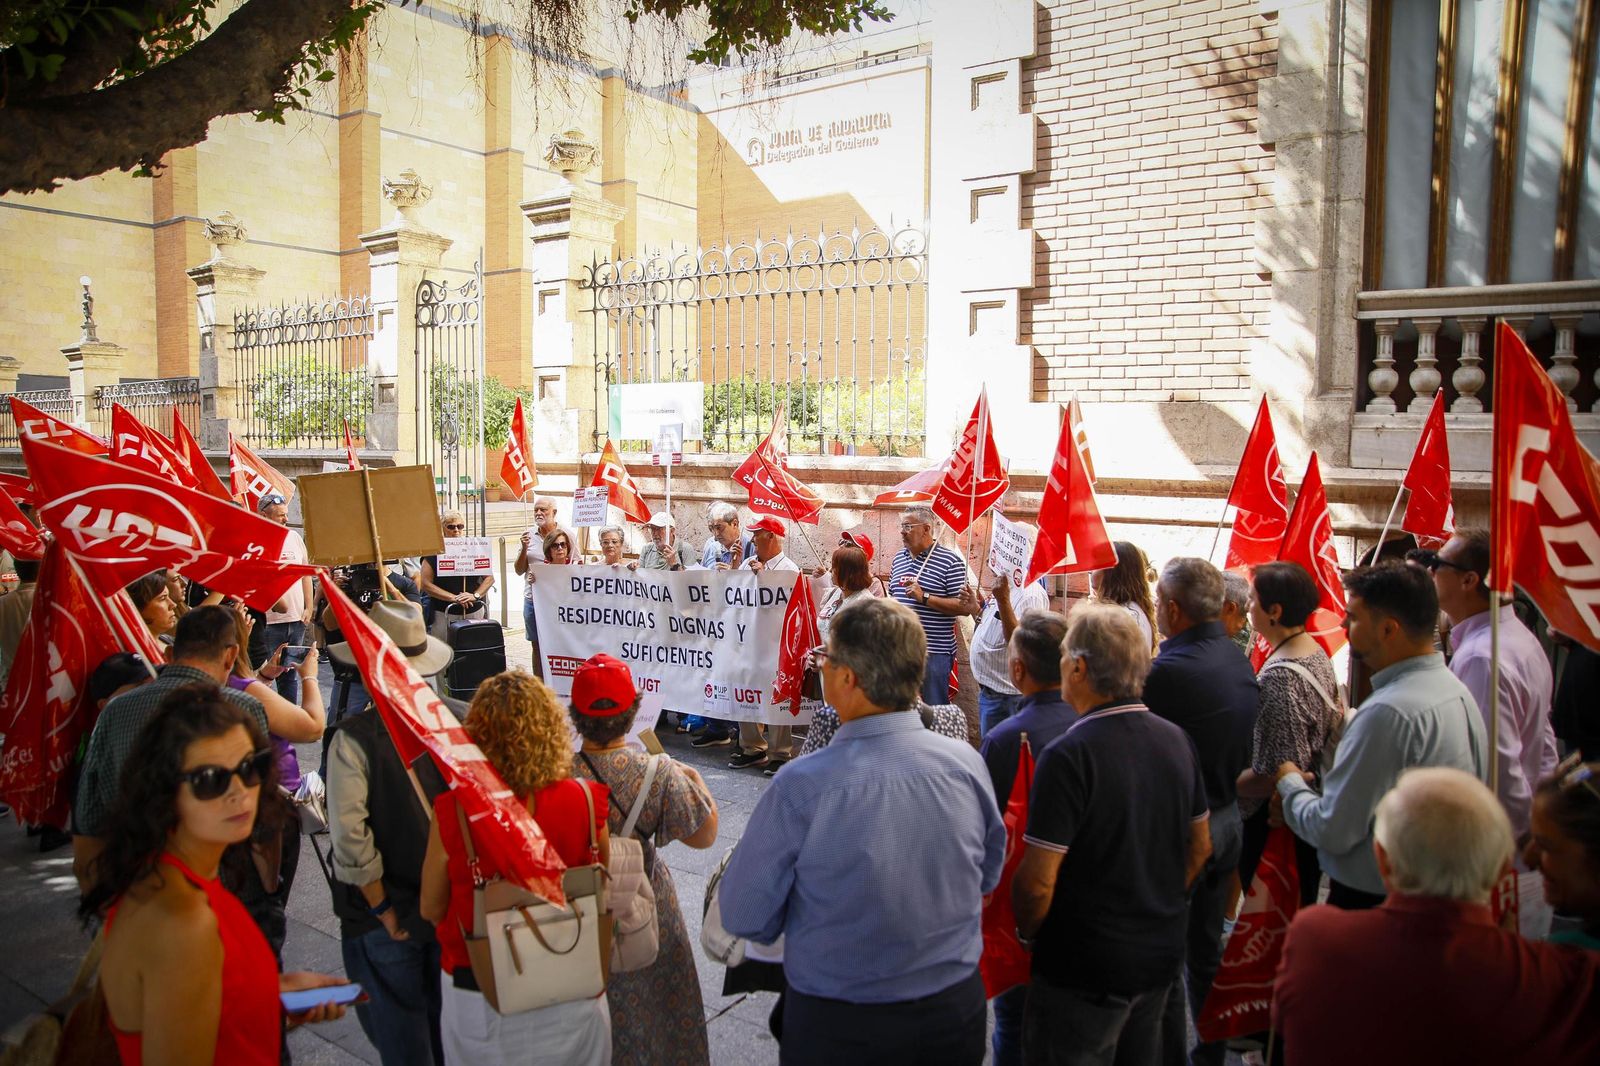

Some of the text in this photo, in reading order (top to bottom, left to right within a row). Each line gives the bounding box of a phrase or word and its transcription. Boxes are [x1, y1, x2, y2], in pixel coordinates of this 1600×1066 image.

[808, 124, 823, 142] DE
[818, 140, 832, 155] del
[836, 136, 879, 152] Gobierno
[1015, 546, 1023, 556] DE
[571, 576, 793, 607] DEPENDENCIA DE CALIDA
[558, 606, 746, 643] RESIDENCIAS DIGNAS Y
[638, 677, 660, 693] UGT
[735, 688, 762, 704] UGT
